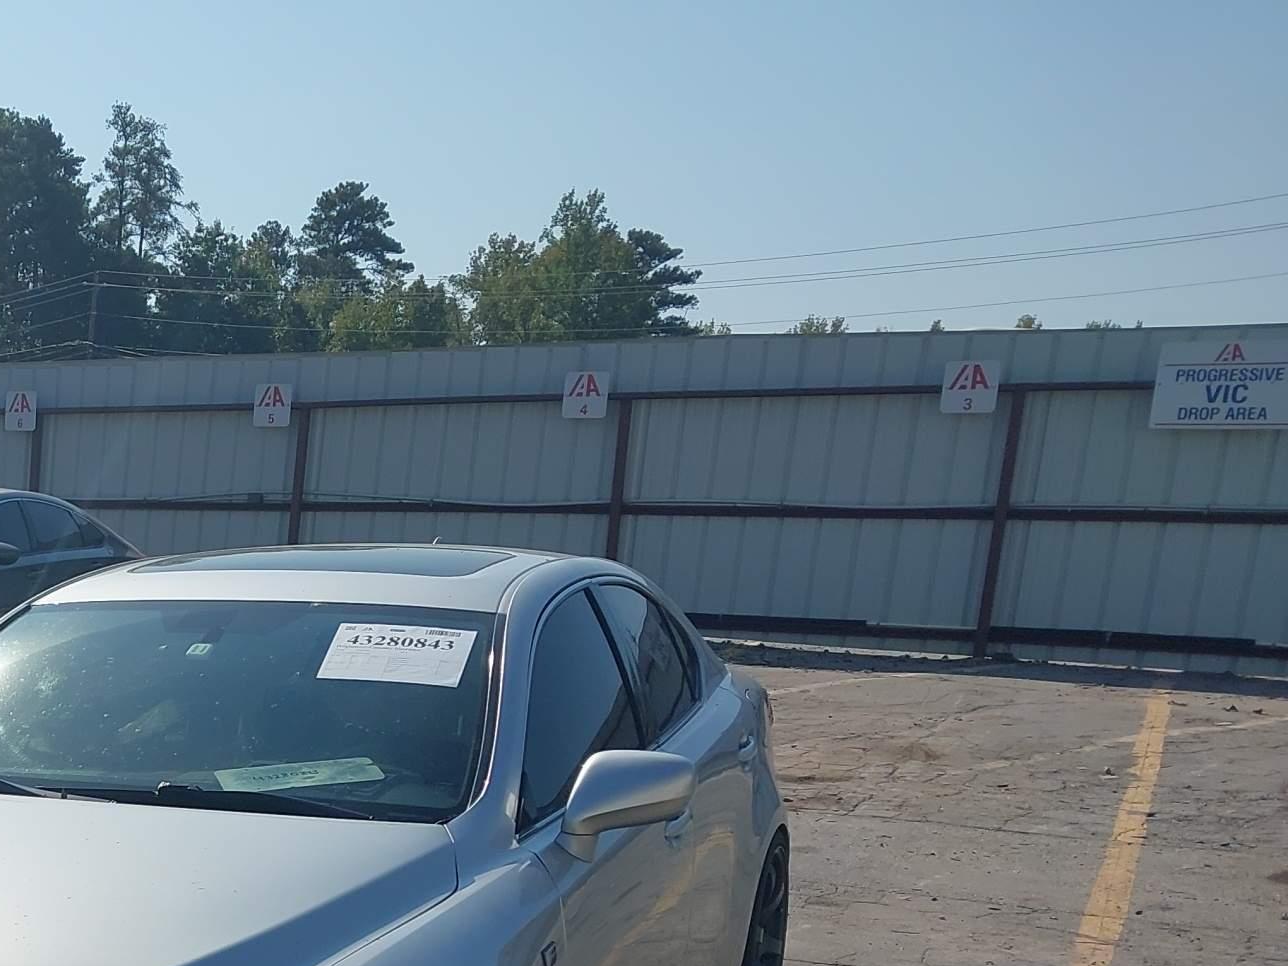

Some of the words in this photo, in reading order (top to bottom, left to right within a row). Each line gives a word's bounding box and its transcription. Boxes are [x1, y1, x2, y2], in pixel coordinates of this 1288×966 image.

[1175, 367, 1286, 382] PROGRESSIVE
[1205, 384, 1249, 404] VIC
[579, 404, 588, 415] 4
[962, 398, 973, 411] 3
[267, 413, 275, 424] 5
[1177, 407, 1221, 420] DROP
[1225, 407, 1268, 420] AREA
[17, 418, 24, 428] 6
[347, 634, 455, 651] 43280843
